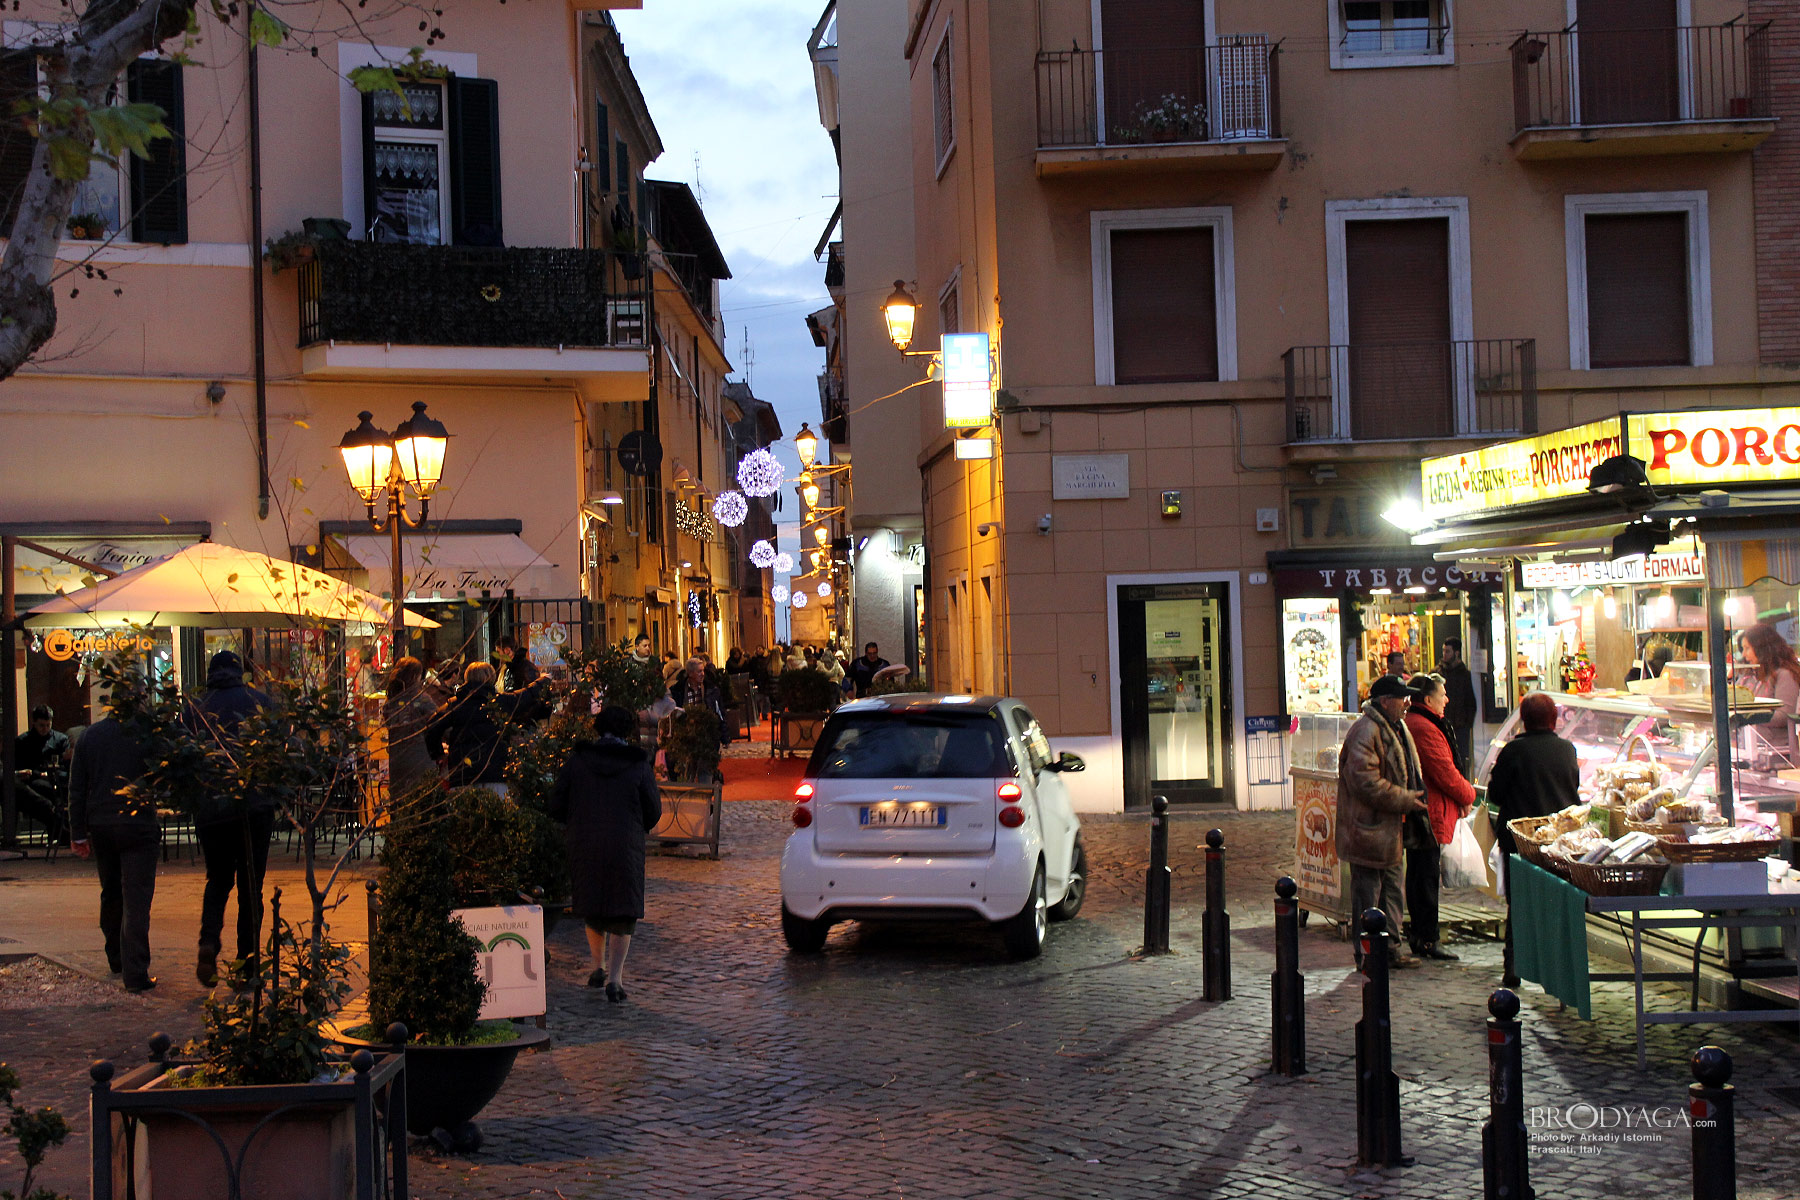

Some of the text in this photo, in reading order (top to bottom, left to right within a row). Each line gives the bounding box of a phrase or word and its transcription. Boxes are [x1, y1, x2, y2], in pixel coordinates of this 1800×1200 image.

[1428, 471, 1463, 505] LEDA
[1469, 467, 1506, 494] REGINA
[54, 544, 153, 565] La Fenice
[415, 570, 509, 589] La Fenice
[1318, 566, 1503, 587] TABACCH
[463, 921, 530, 932] RCIALE NATURALE
